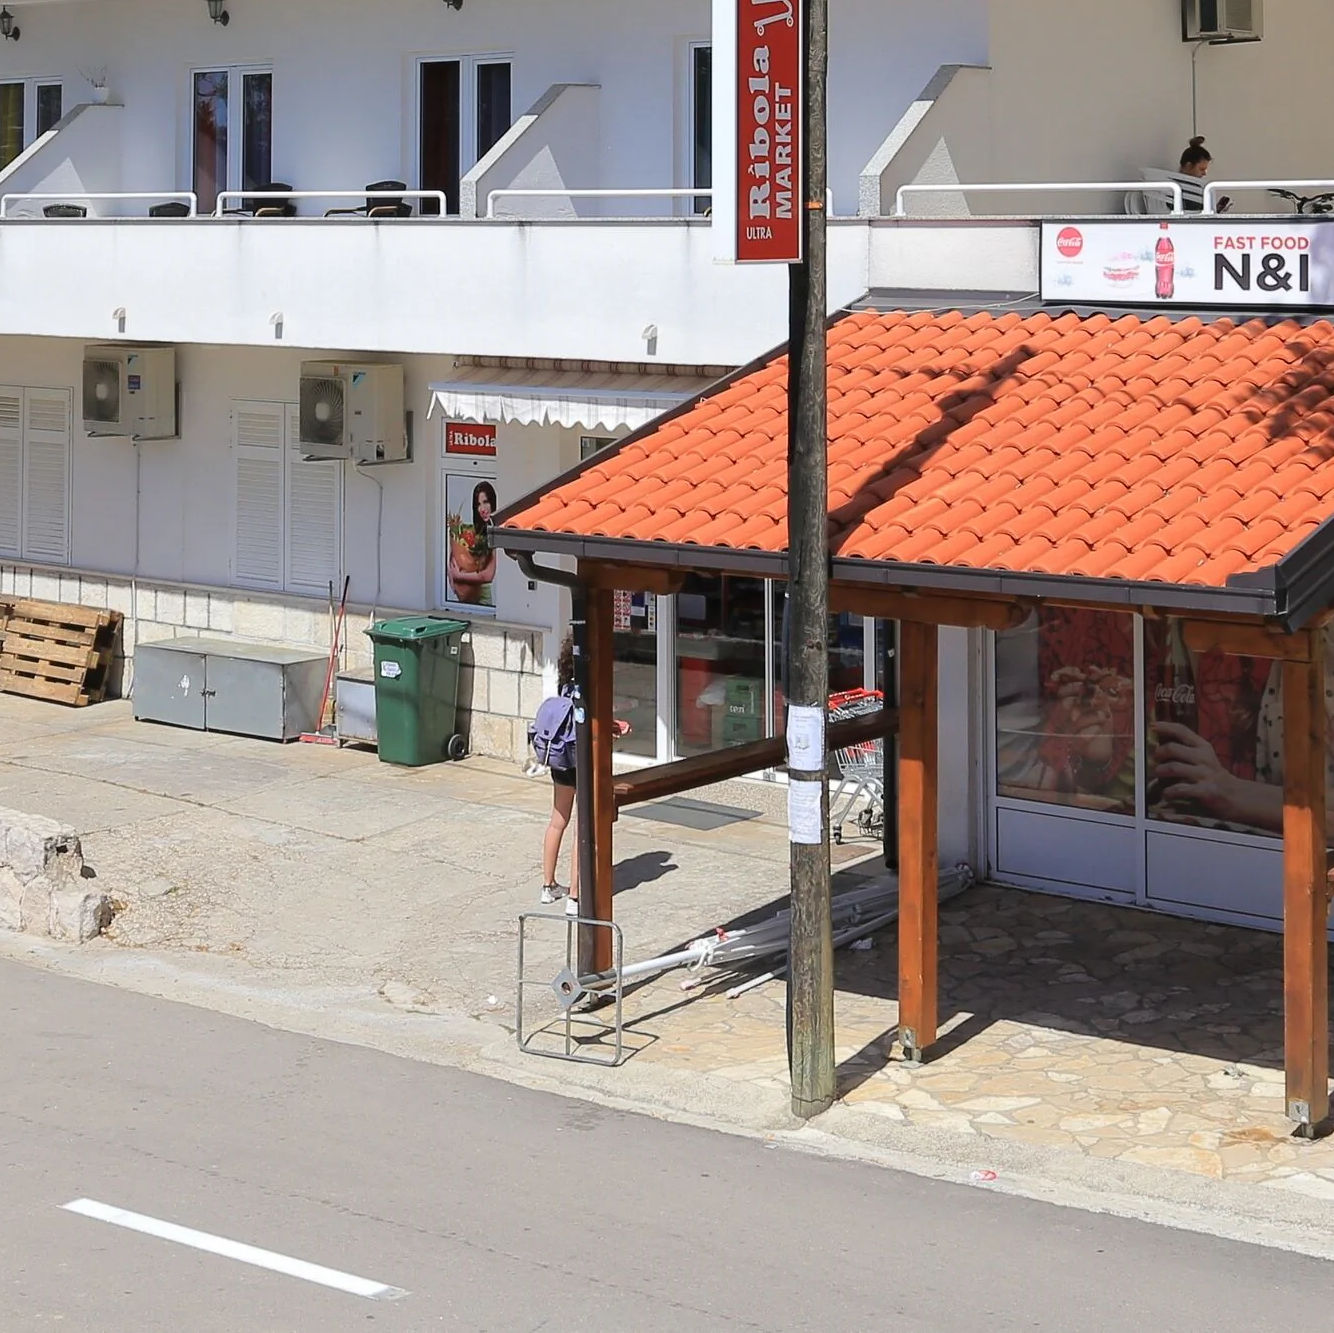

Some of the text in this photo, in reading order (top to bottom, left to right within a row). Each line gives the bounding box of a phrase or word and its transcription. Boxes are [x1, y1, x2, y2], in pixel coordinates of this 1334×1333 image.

[748, 45, 771, 220] Ribola
[775, 82, 792, 219] MARKET
[746, 226, 772, 240] ULTRA
[1214, 236, 1309, 250] FAST FOOD
[1214, 253, 1309, 292] N&I
[454, 432, 497, 447] Ribola
